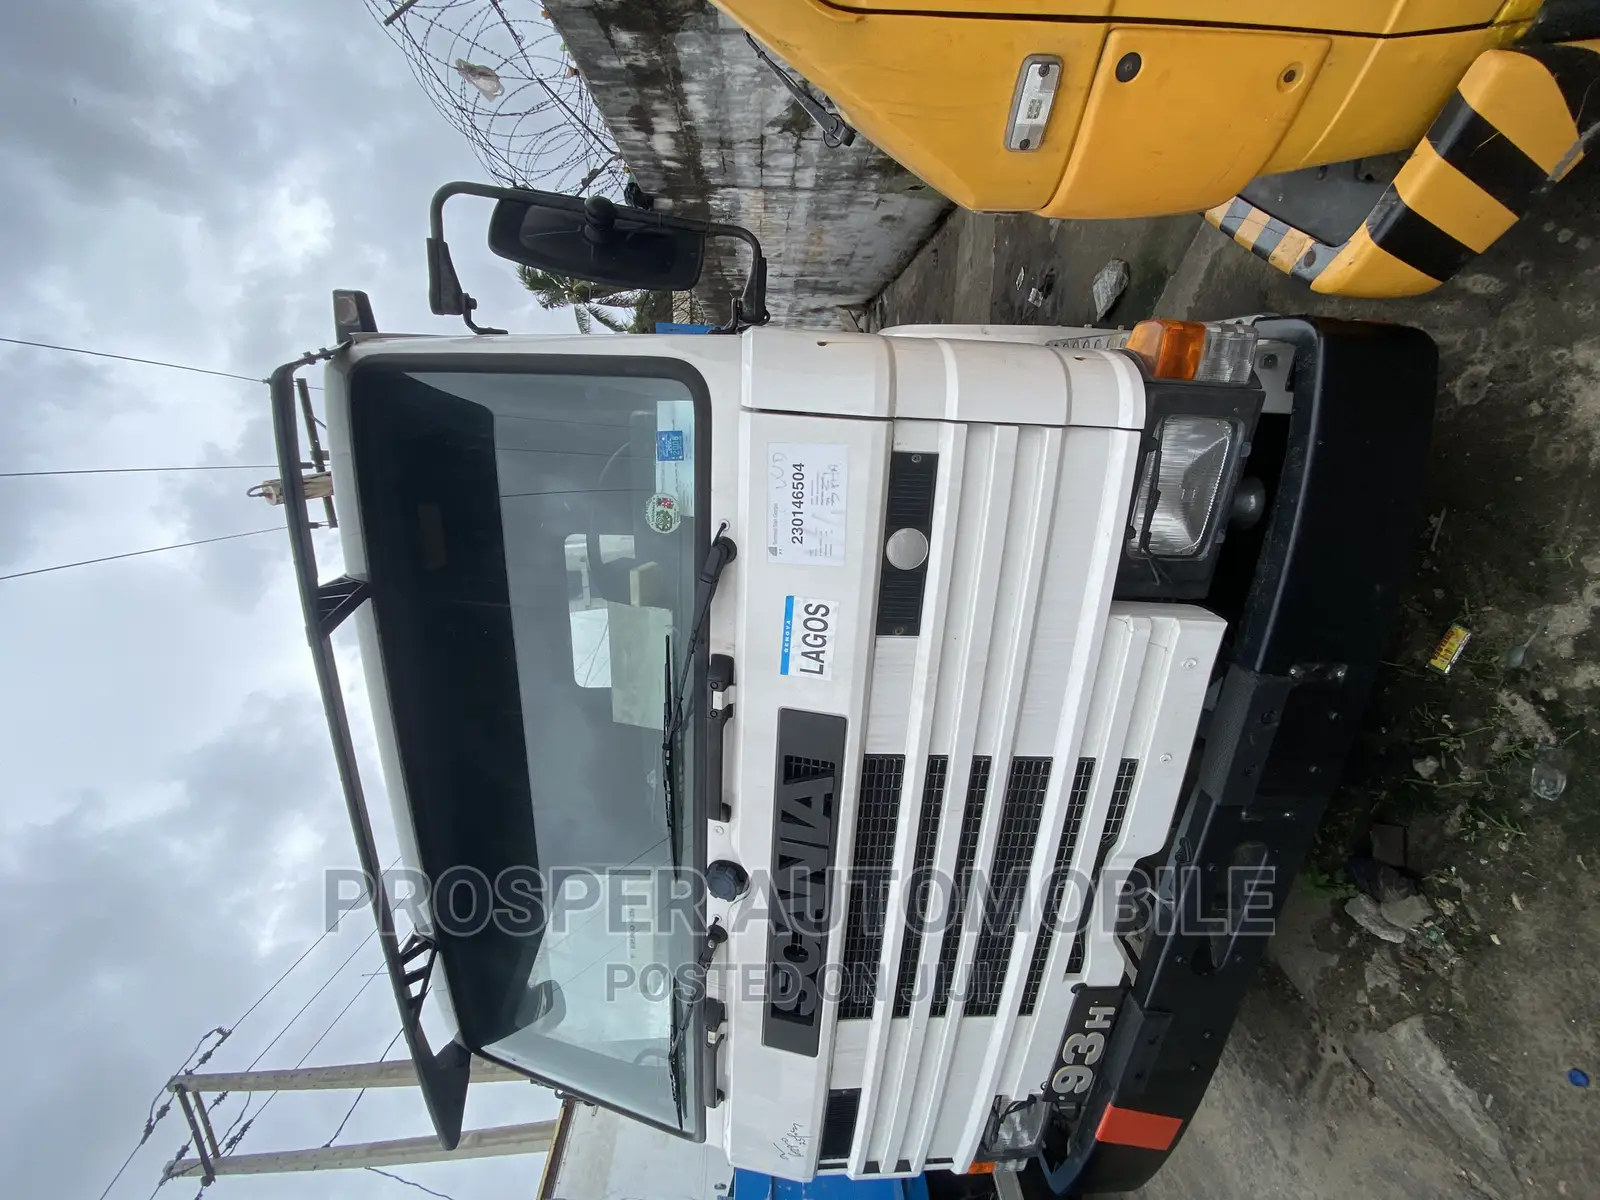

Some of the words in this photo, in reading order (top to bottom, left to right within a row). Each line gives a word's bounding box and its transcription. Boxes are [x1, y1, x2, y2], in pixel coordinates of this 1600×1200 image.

[791, 463, 805, 545] 230146504
[800, 603, 830, 675] LAGOS
[771, 775, 835, 1016] SCANIA
